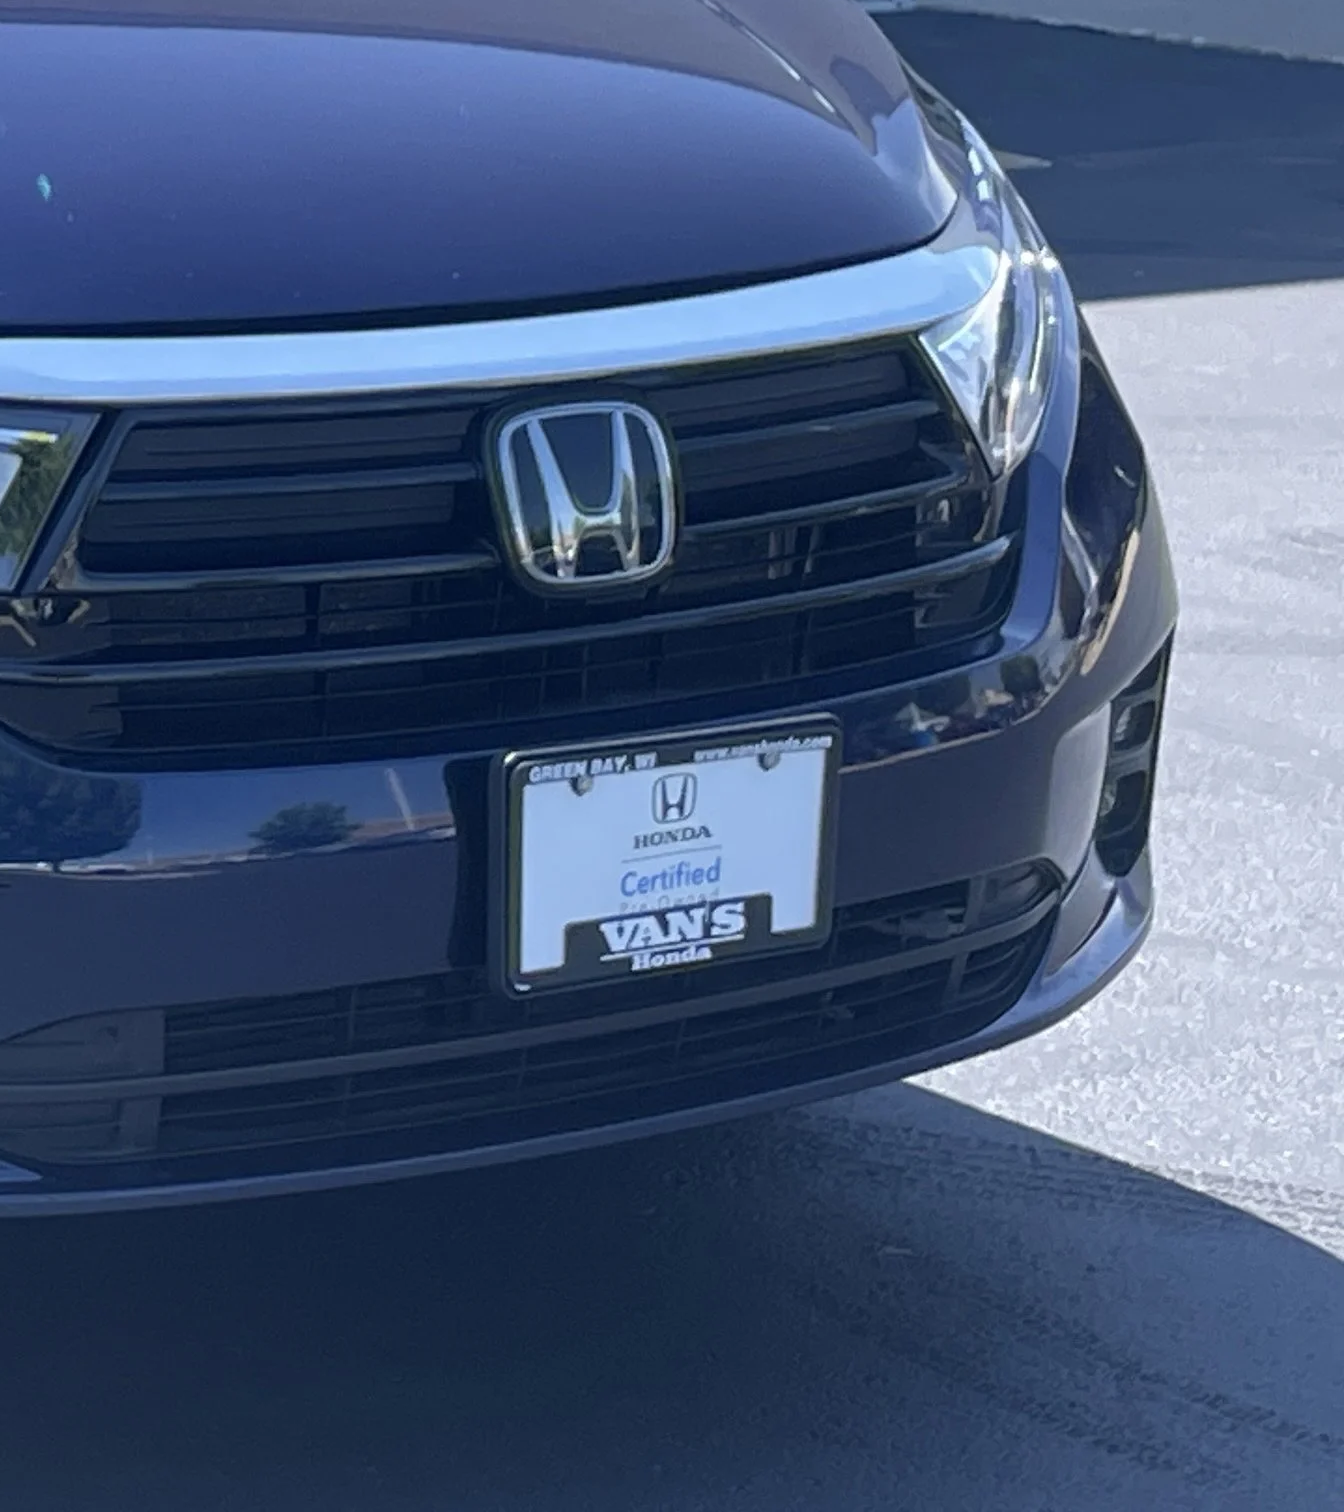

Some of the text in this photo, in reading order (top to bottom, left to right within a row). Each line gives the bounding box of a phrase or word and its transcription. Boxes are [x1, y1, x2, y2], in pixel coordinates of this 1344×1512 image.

[528, 759, 588, 784] GREEN
[633, 825, 713, 849] HONDA
[620, 855, 721, 898] Certified
[630, 944, 713, 972] Honda
